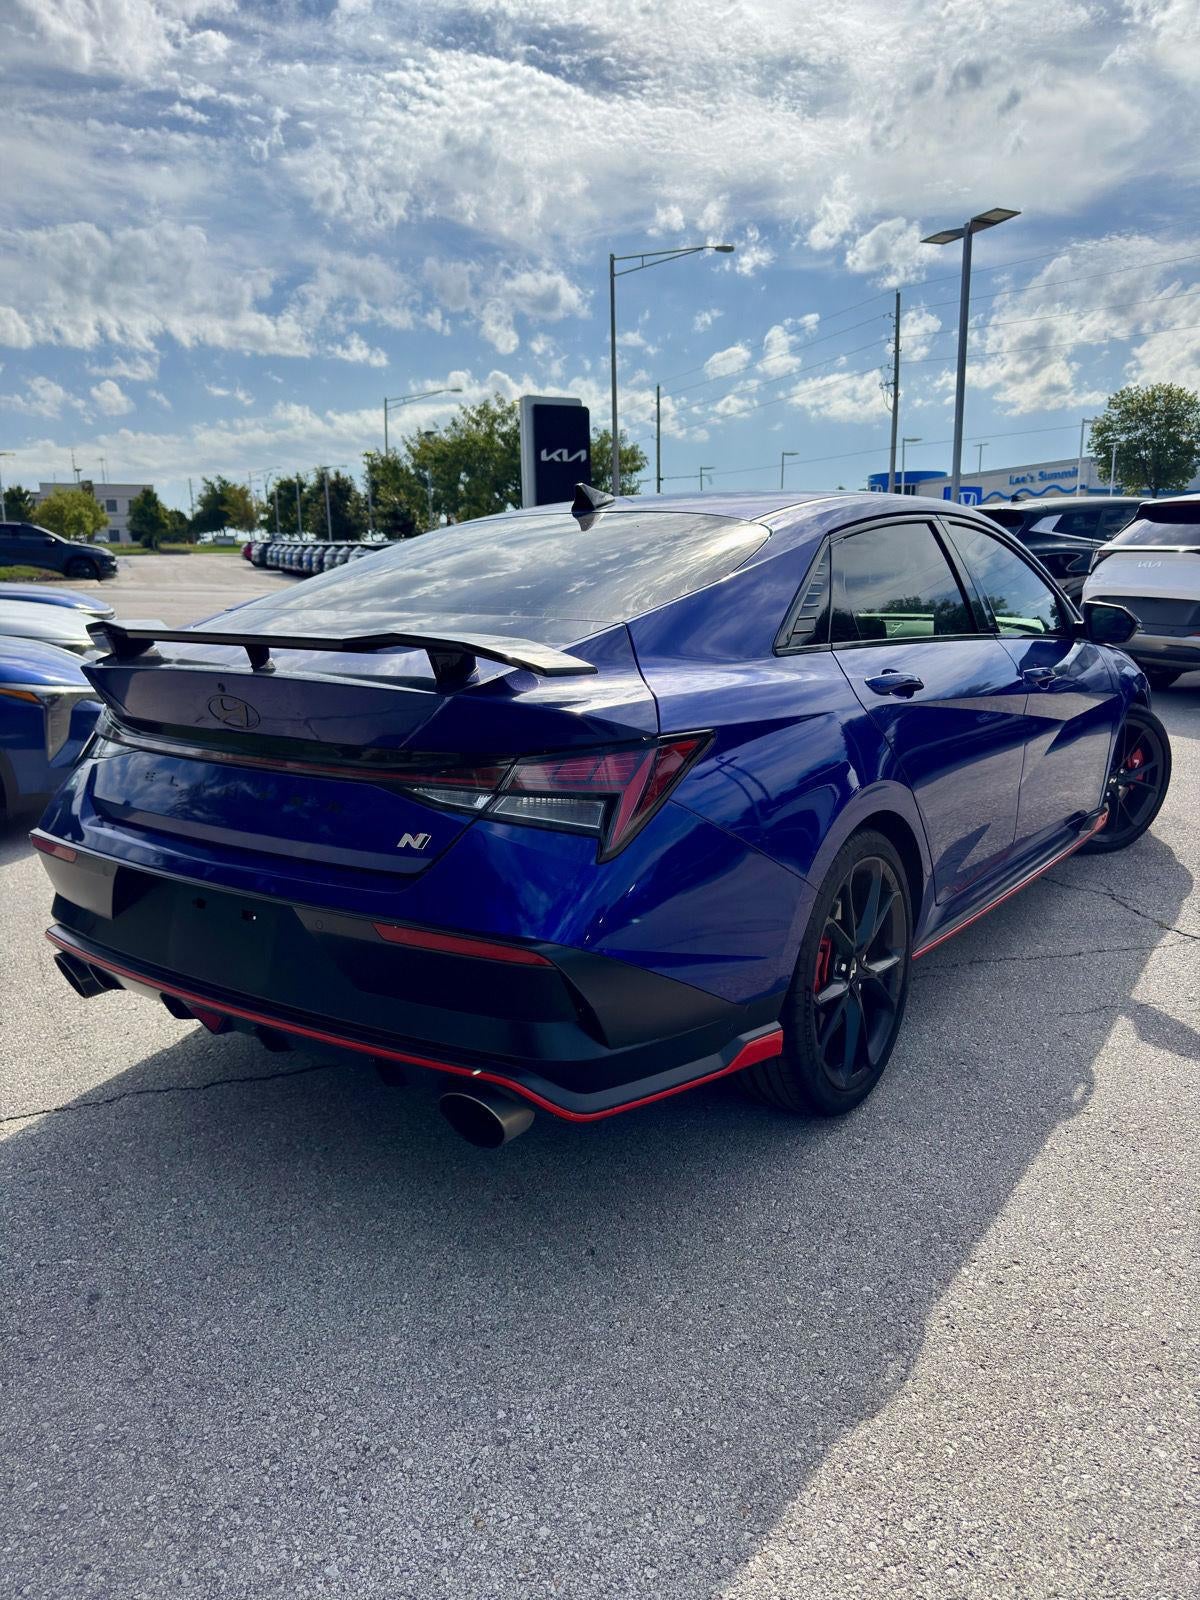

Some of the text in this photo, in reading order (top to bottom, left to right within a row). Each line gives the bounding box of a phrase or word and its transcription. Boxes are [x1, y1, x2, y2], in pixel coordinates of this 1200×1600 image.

[541, 449, 587, 462] KIA
[1009, 473, 1034, 485] Lee's
[397, 832, 431, 849] N
